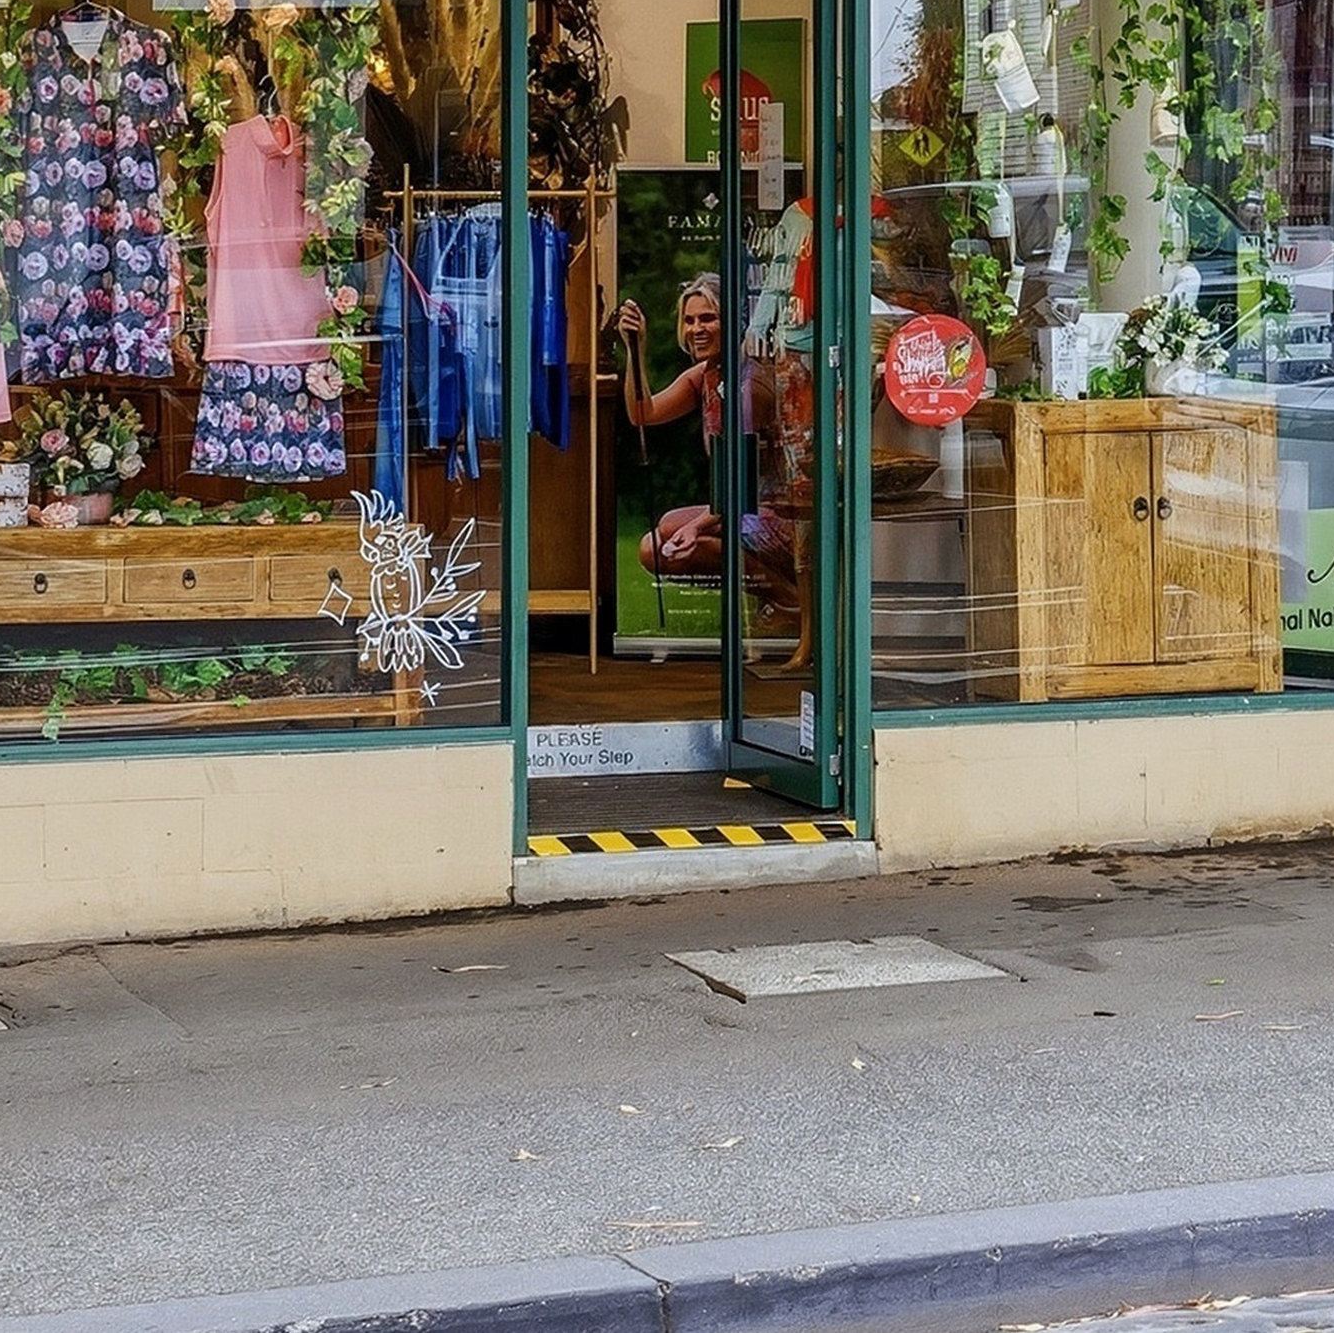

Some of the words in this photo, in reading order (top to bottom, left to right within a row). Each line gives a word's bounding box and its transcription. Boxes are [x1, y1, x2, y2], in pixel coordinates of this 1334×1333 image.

[536, 730, 603, 748] PLEASE
[559, 751, 593, 767] Your
[597, 748, 634, 765] Step
